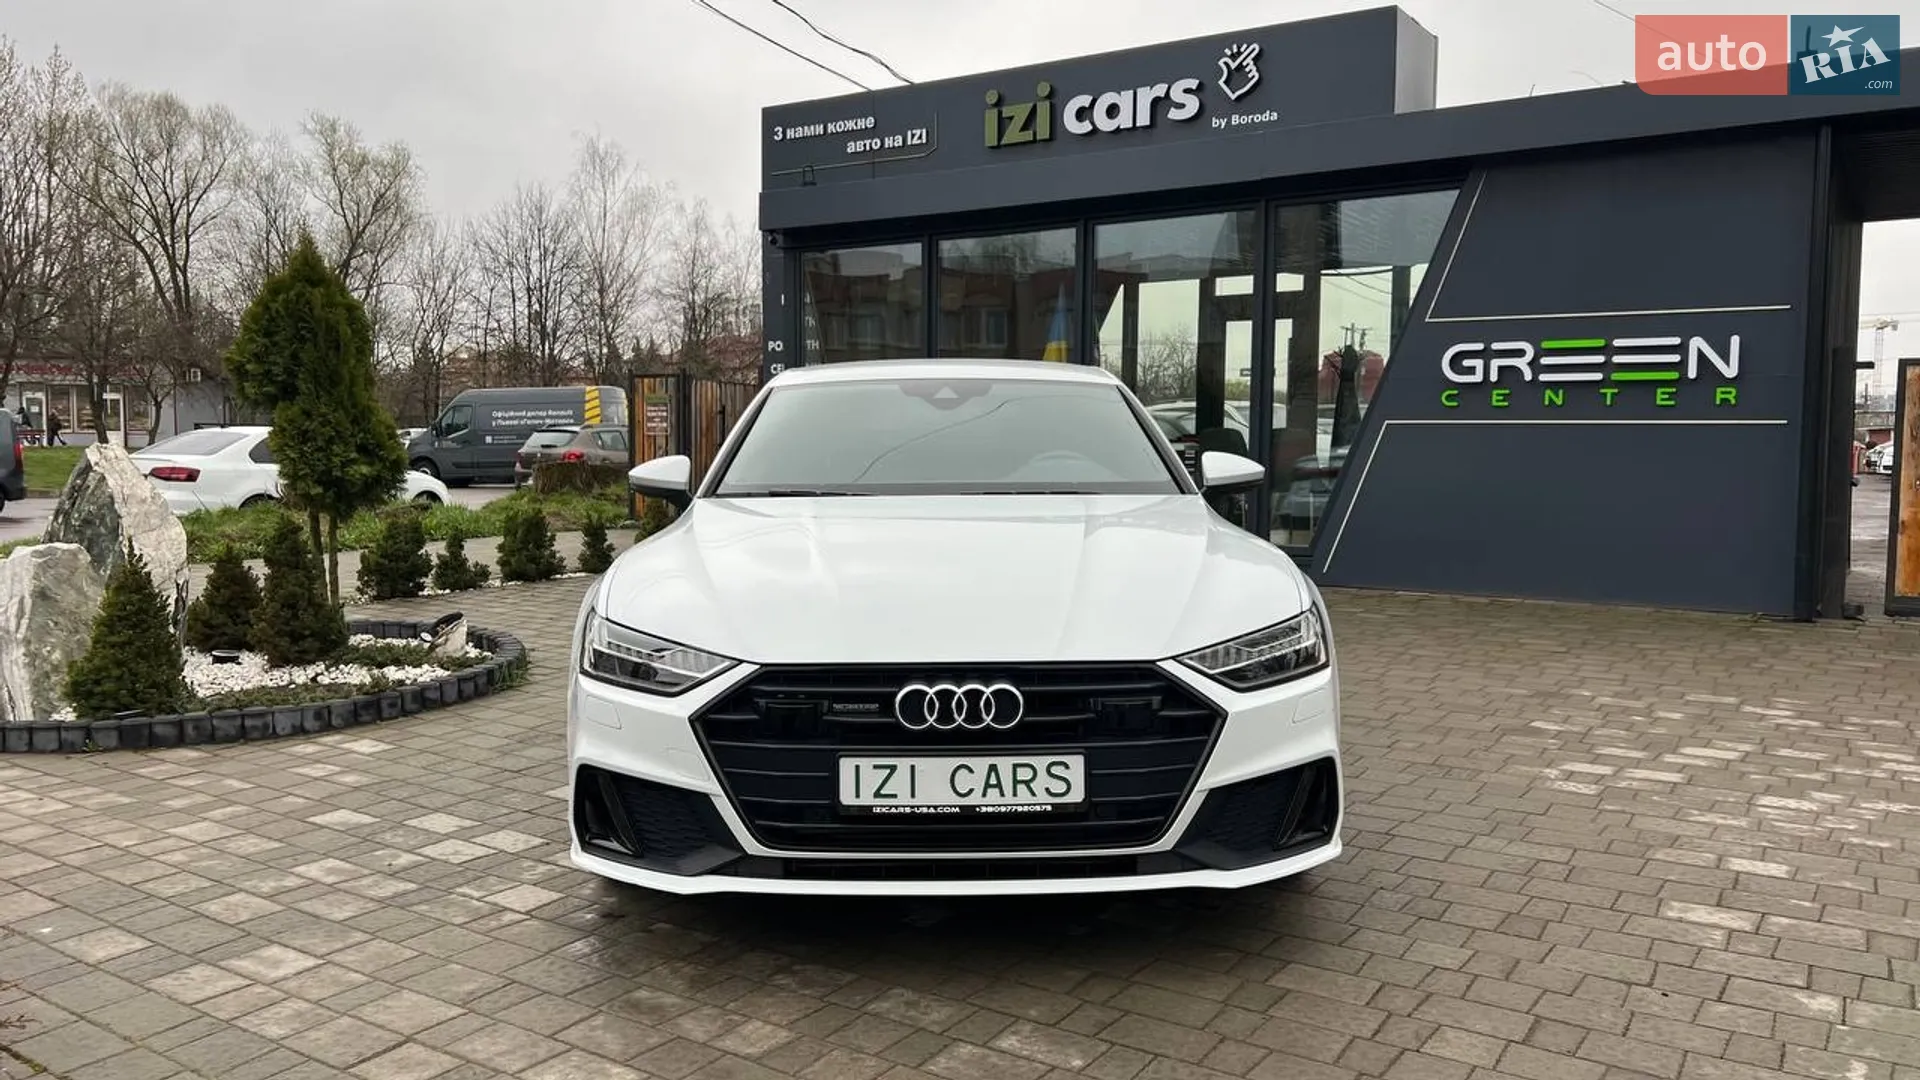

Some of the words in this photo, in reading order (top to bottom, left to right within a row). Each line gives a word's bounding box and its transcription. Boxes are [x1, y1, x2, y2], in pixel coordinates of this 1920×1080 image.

[984, 81, 1051, 147] izi
[1063, 78, 1201, 135] cars
[1211, 116, 1227, 130] by
[1231, 110, 1278, 126] Boroda
[786, 122, 824, 140] нами
[827, 115, 875, 134] кожне
[846, 138, 881, 154] авто
[884, 134, 903, 149] на
[907, 127, 927, 146] IZI
[1441, 334, 1741, 383] GREEN
[1440, 386, 1738, 406] CENTER
[854, 763, 917, 799] IZI
[949, 760, 1073, 799] CARS
